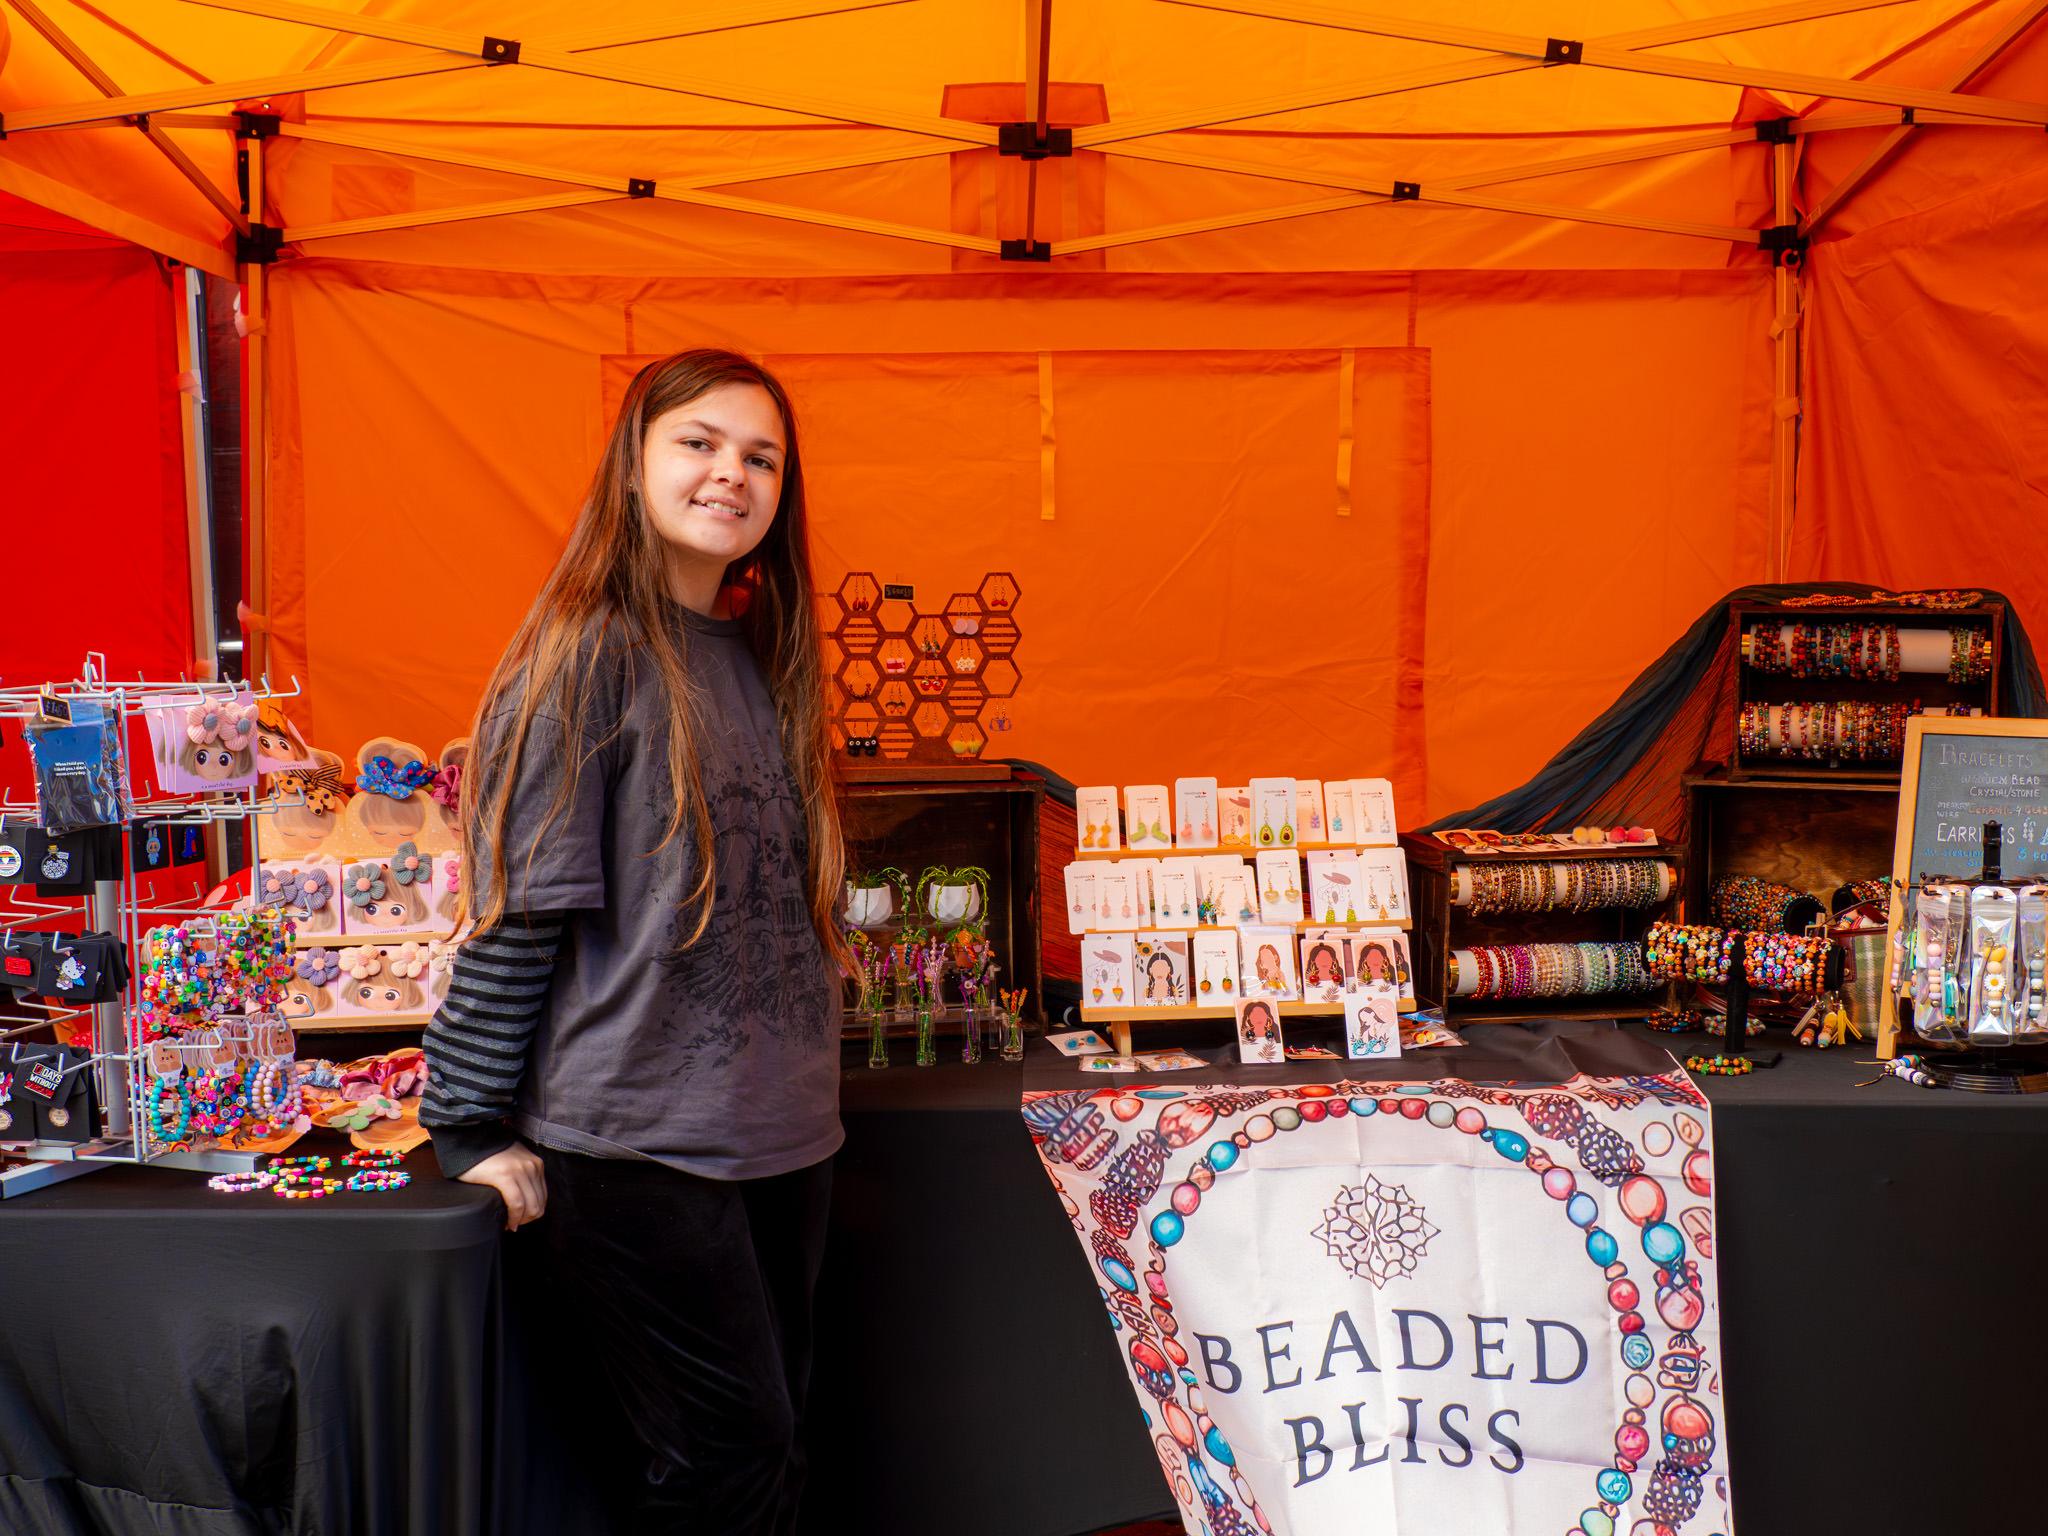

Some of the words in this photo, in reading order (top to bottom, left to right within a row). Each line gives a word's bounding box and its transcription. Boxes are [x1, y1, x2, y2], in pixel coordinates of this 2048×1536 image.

[1939, 743, 2033, 769] BRACELETS
[2011, 773, 2040, 785] BEAD
[30, 1073, 59, 1091] WITHOUT
[42, 1068, 63, 1084] DAYS
[1193, 1308, 1589, 1395] BEADED
[1283, 1396, 1525, 1489] BLISS
